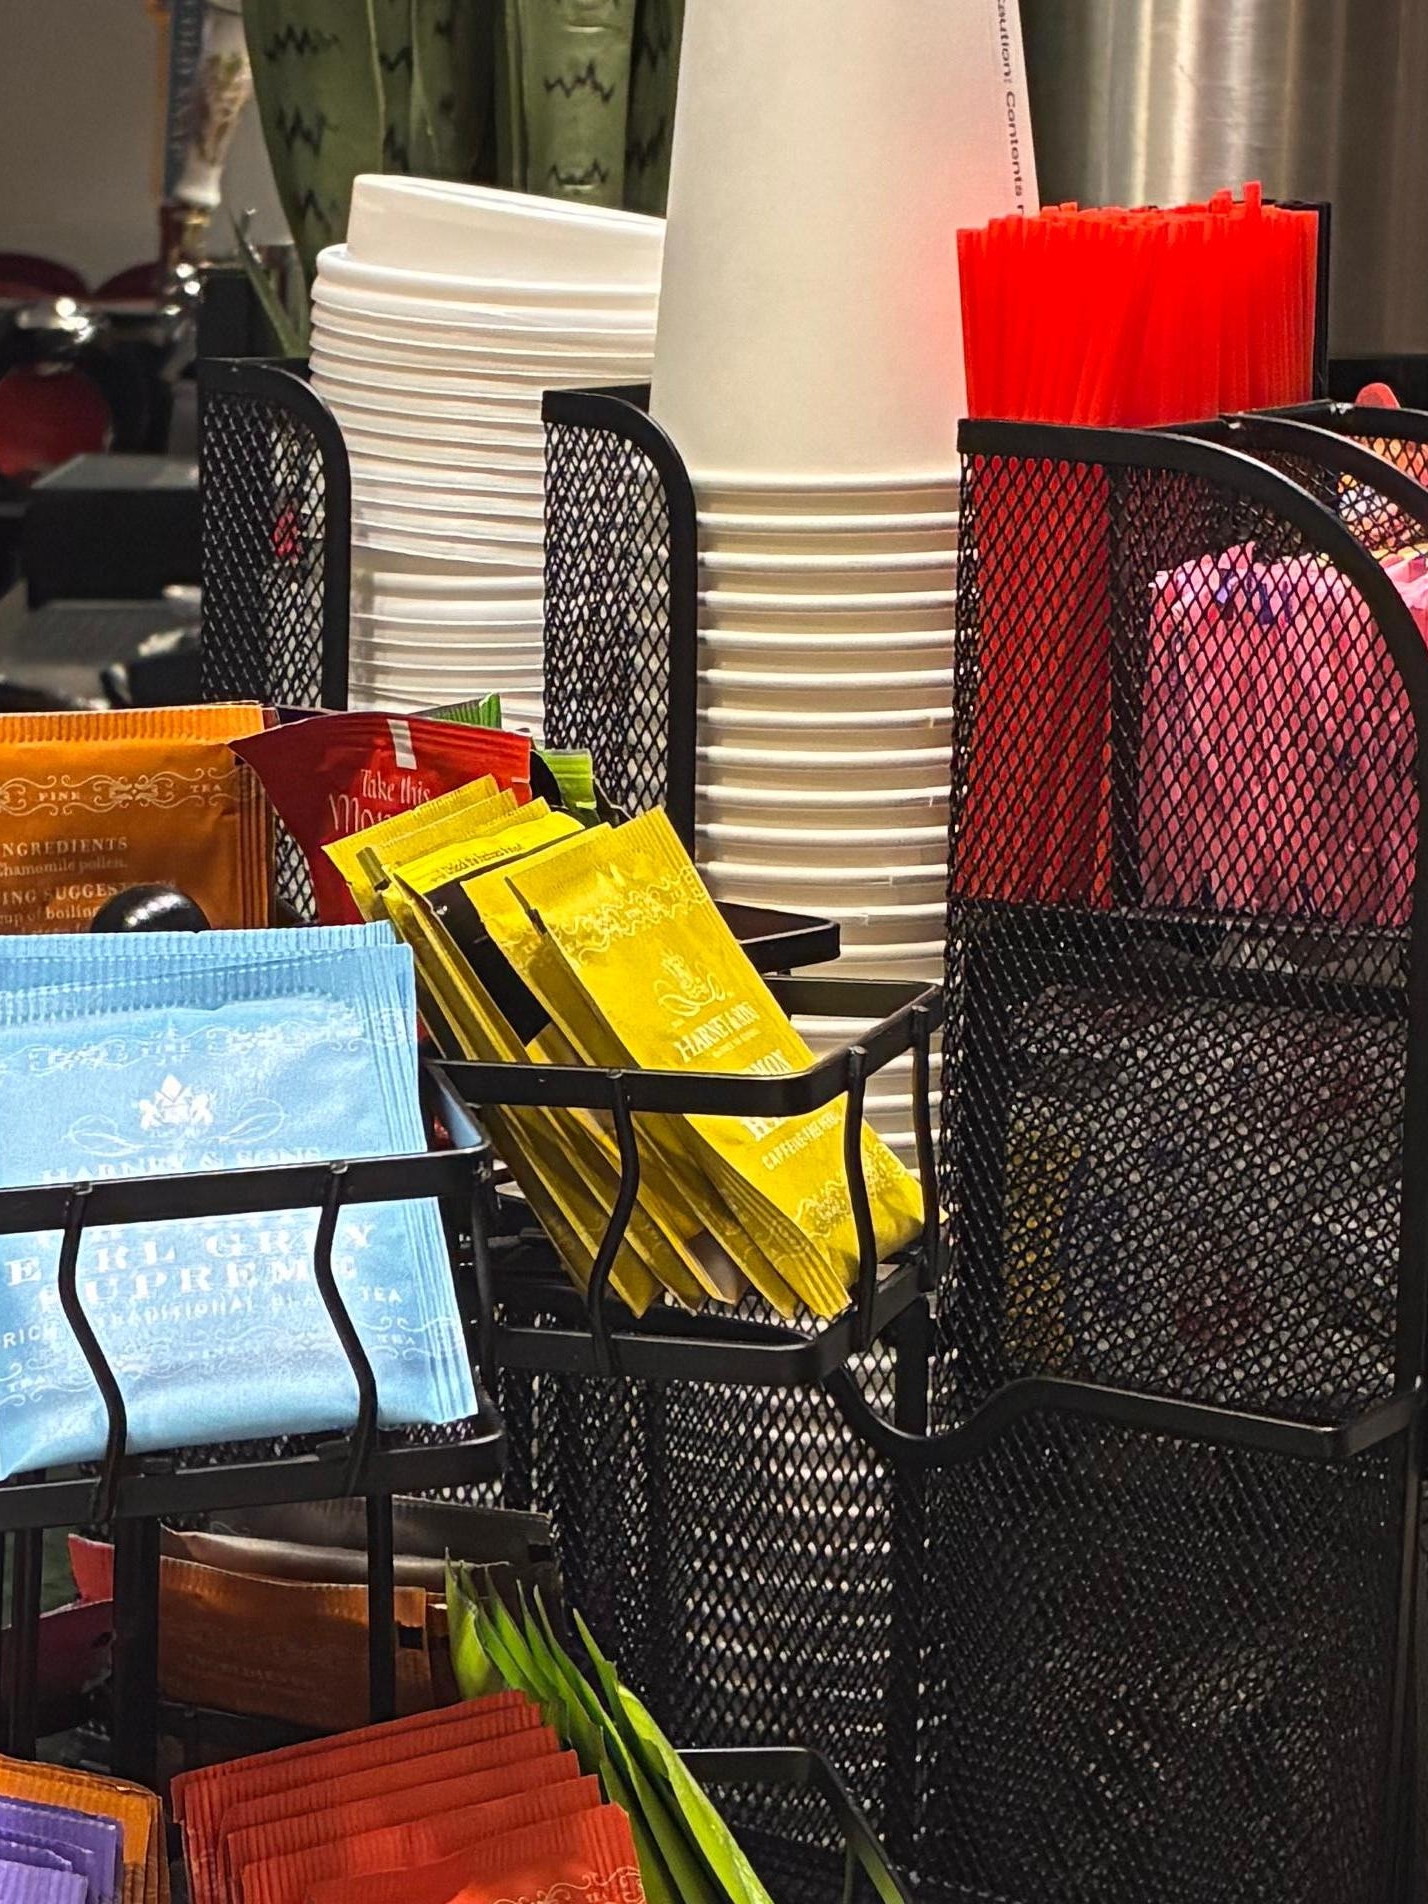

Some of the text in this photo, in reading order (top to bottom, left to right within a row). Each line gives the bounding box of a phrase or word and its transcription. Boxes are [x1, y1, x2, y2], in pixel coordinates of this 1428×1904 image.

[1006, 90, 1024, 197] Contents
[38, 782, 222, 802] FINE TEA
[360, 769, 395, 802] Take
[4, 1223, 375, 1287] ERL GRY
[360, 1286, 403, 1304] TEA
